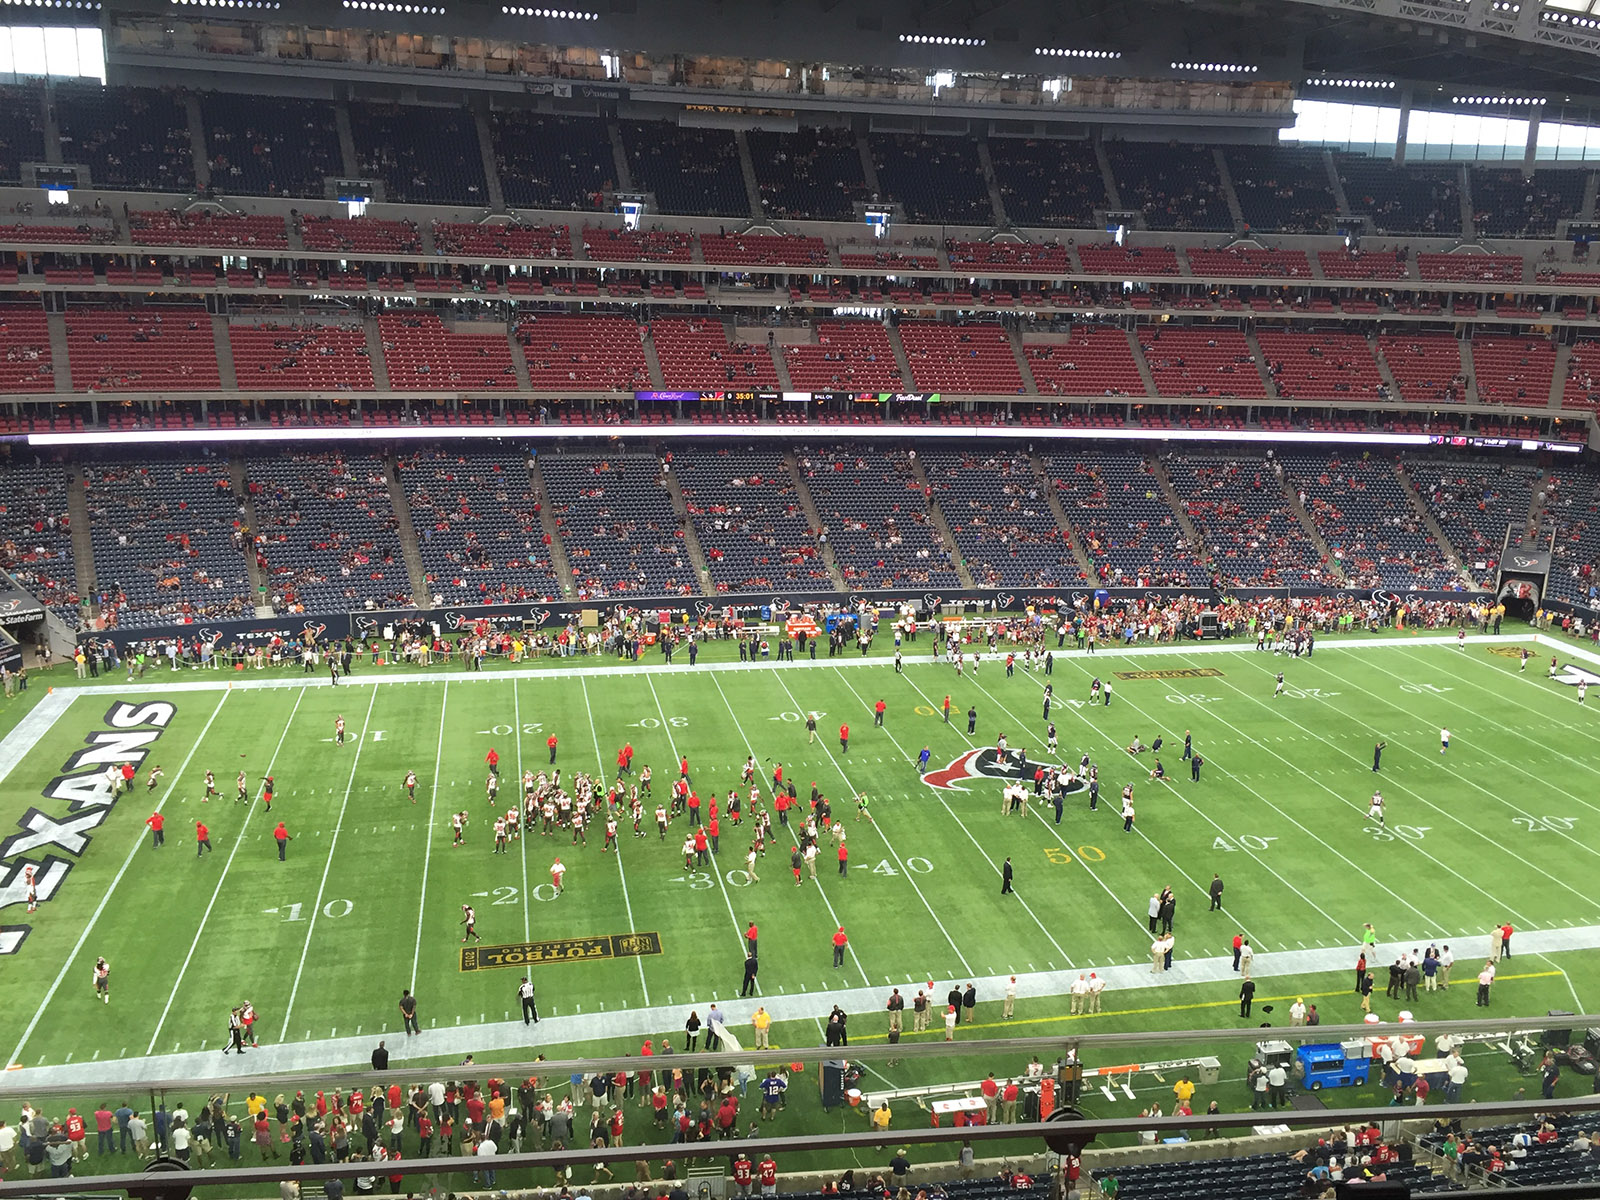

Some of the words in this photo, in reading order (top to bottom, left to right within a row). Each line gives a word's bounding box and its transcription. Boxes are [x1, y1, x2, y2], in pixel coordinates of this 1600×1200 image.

[735, 392, 754, 400] 35:01
[895, 394, 924, 402] FanDuel
[559, 612, 605, 620] TEXS
[236, 630, 291, 640] TEXANS
[0, 700, 177, 954] EXANS
[502, 941, 594, 954] AMERICANO
[464, 951, 475, 967] 2015
[768, 1085, 780, 1096] 12
[70, 1122, 81, 1132] 93
[737, 1169, 750, 1179] 93
[763, 1169, 774, 1178] 47
